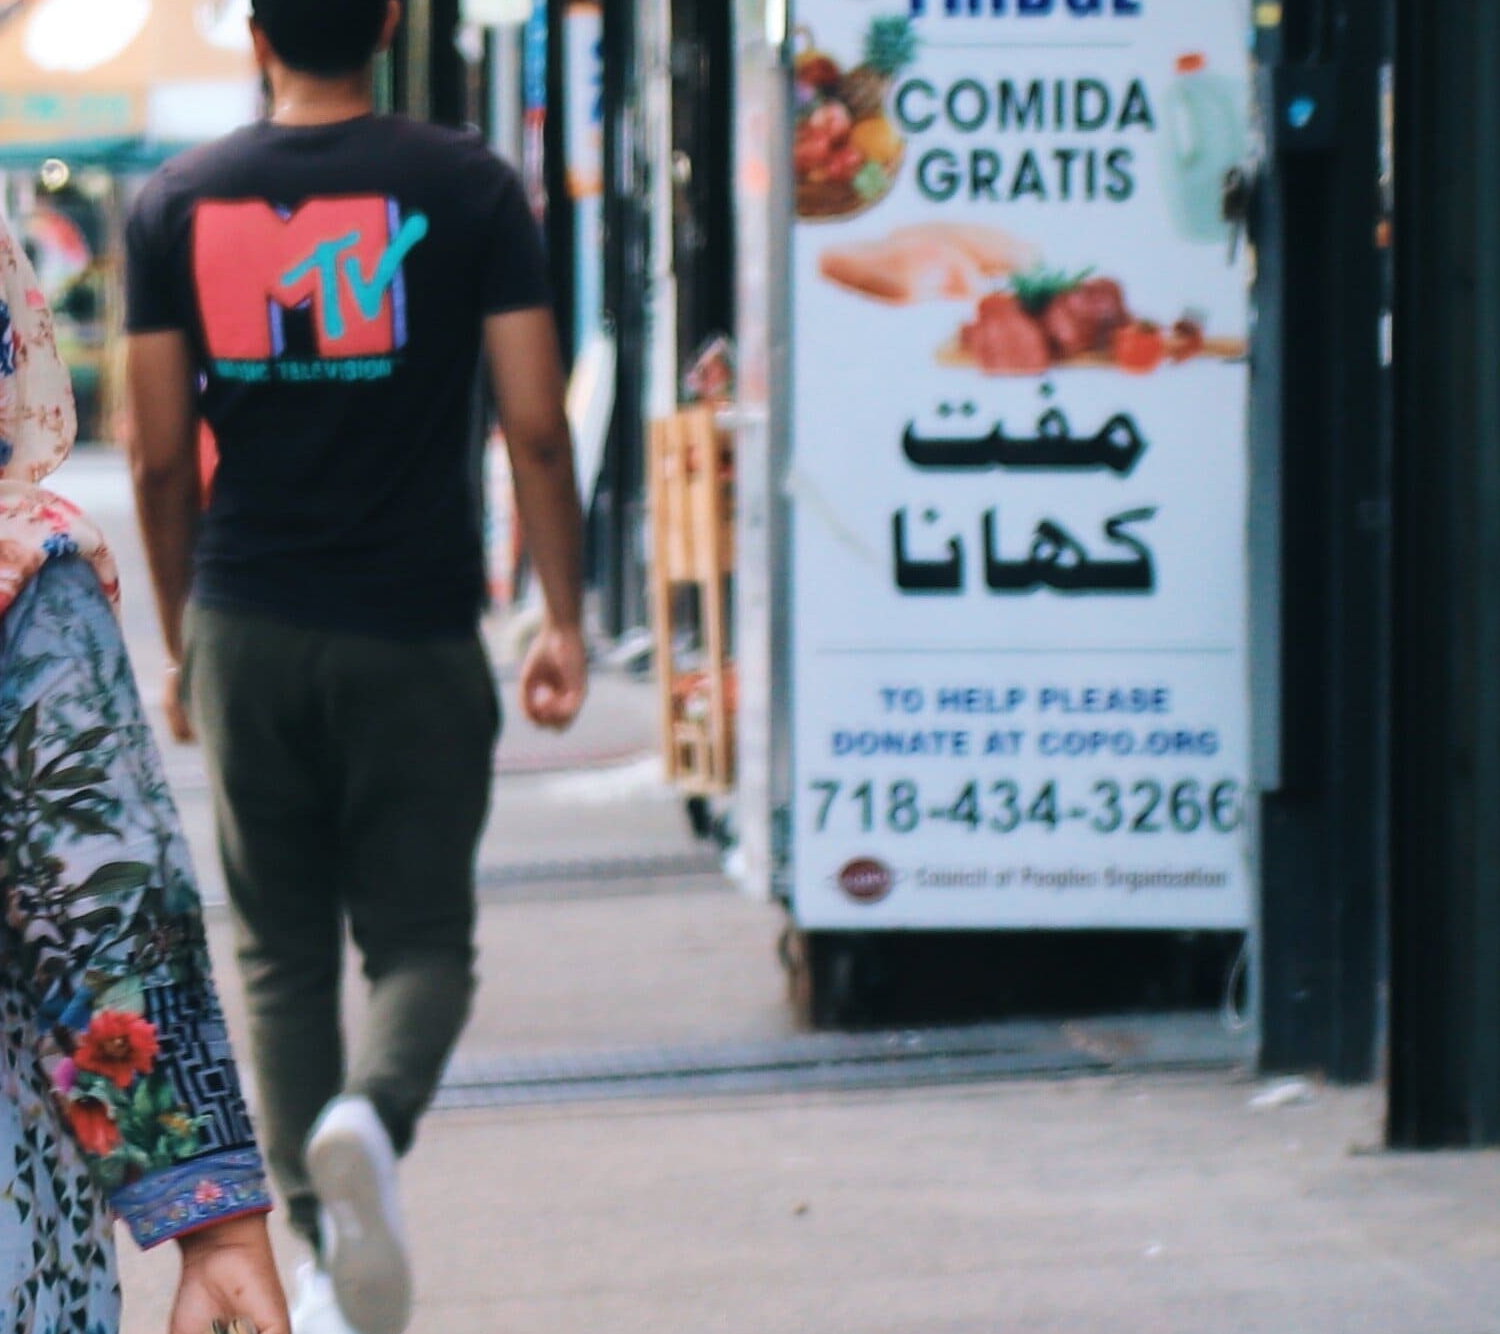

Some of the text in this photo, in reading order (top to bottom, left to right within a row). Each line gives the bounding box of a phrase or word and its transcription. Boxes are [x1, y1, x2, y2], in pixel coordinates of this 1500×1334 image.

[896, 78, 1155, 134] COMIDA
[916, 148, 1135, 202] GRATIS
[193, 195, 429, 359] MTV
[900, 381, 1150, 479] مفت
[880, 687, 1172, 714] TO HELP PLEASE
[831, 730, 1220, 758] DONATE AT COPO.ORG
[809, 779, 1242, 833] 718-434-3266
